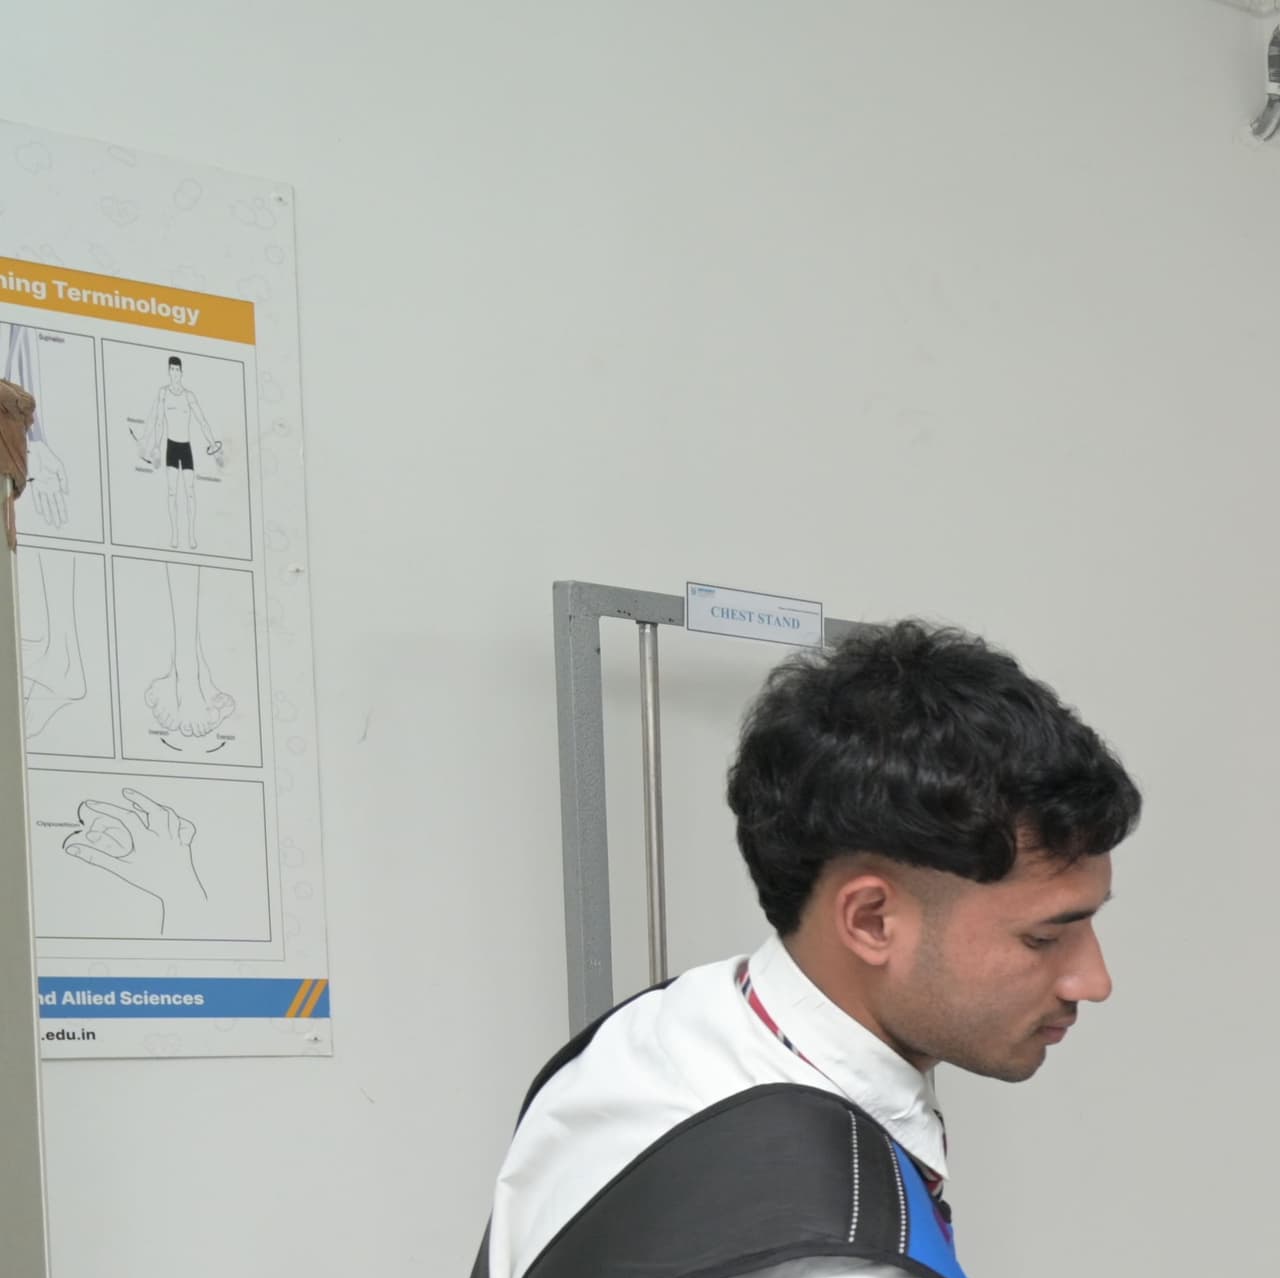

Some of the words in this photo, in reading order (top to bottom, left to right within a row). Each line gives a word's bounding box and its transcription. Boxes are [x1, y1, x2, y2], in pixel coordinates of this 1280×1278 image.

[52, 280, 200, 326] Terminology
[710, 606, 756, 623] CHEST
[757, 612, 800, 630] STAND
[62, 990, 116, 1006] Allied
[120, 990, 204, 1006] Sciences
